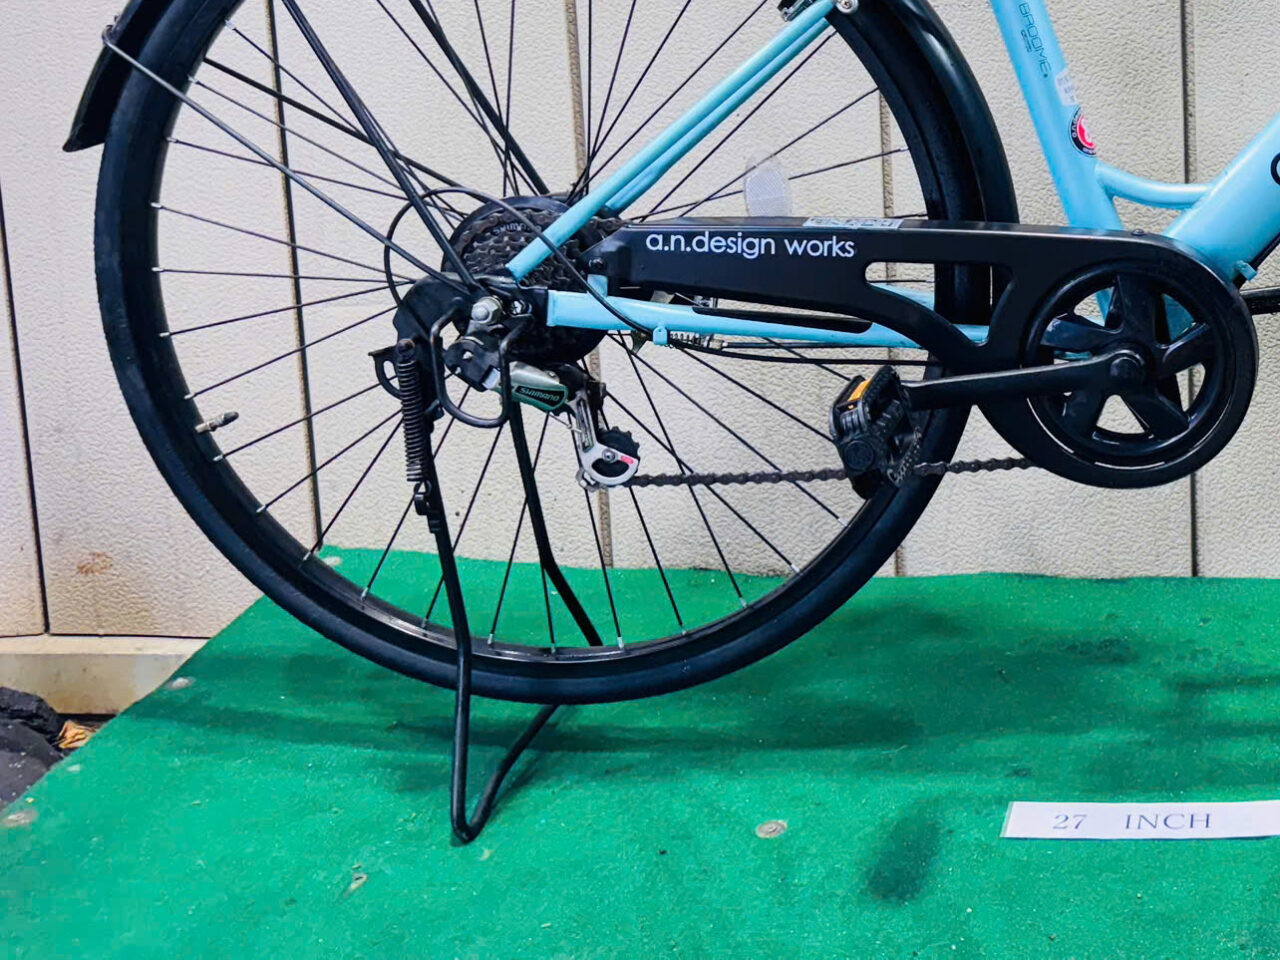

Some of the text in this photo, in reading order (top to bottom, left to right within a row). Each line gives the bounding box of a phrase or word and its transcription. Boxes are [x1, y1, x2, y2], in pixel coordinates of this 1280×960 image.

[646, 231, 855, 259] a.n.design works
[1053, 813, 1210, 830] 27 INCH
